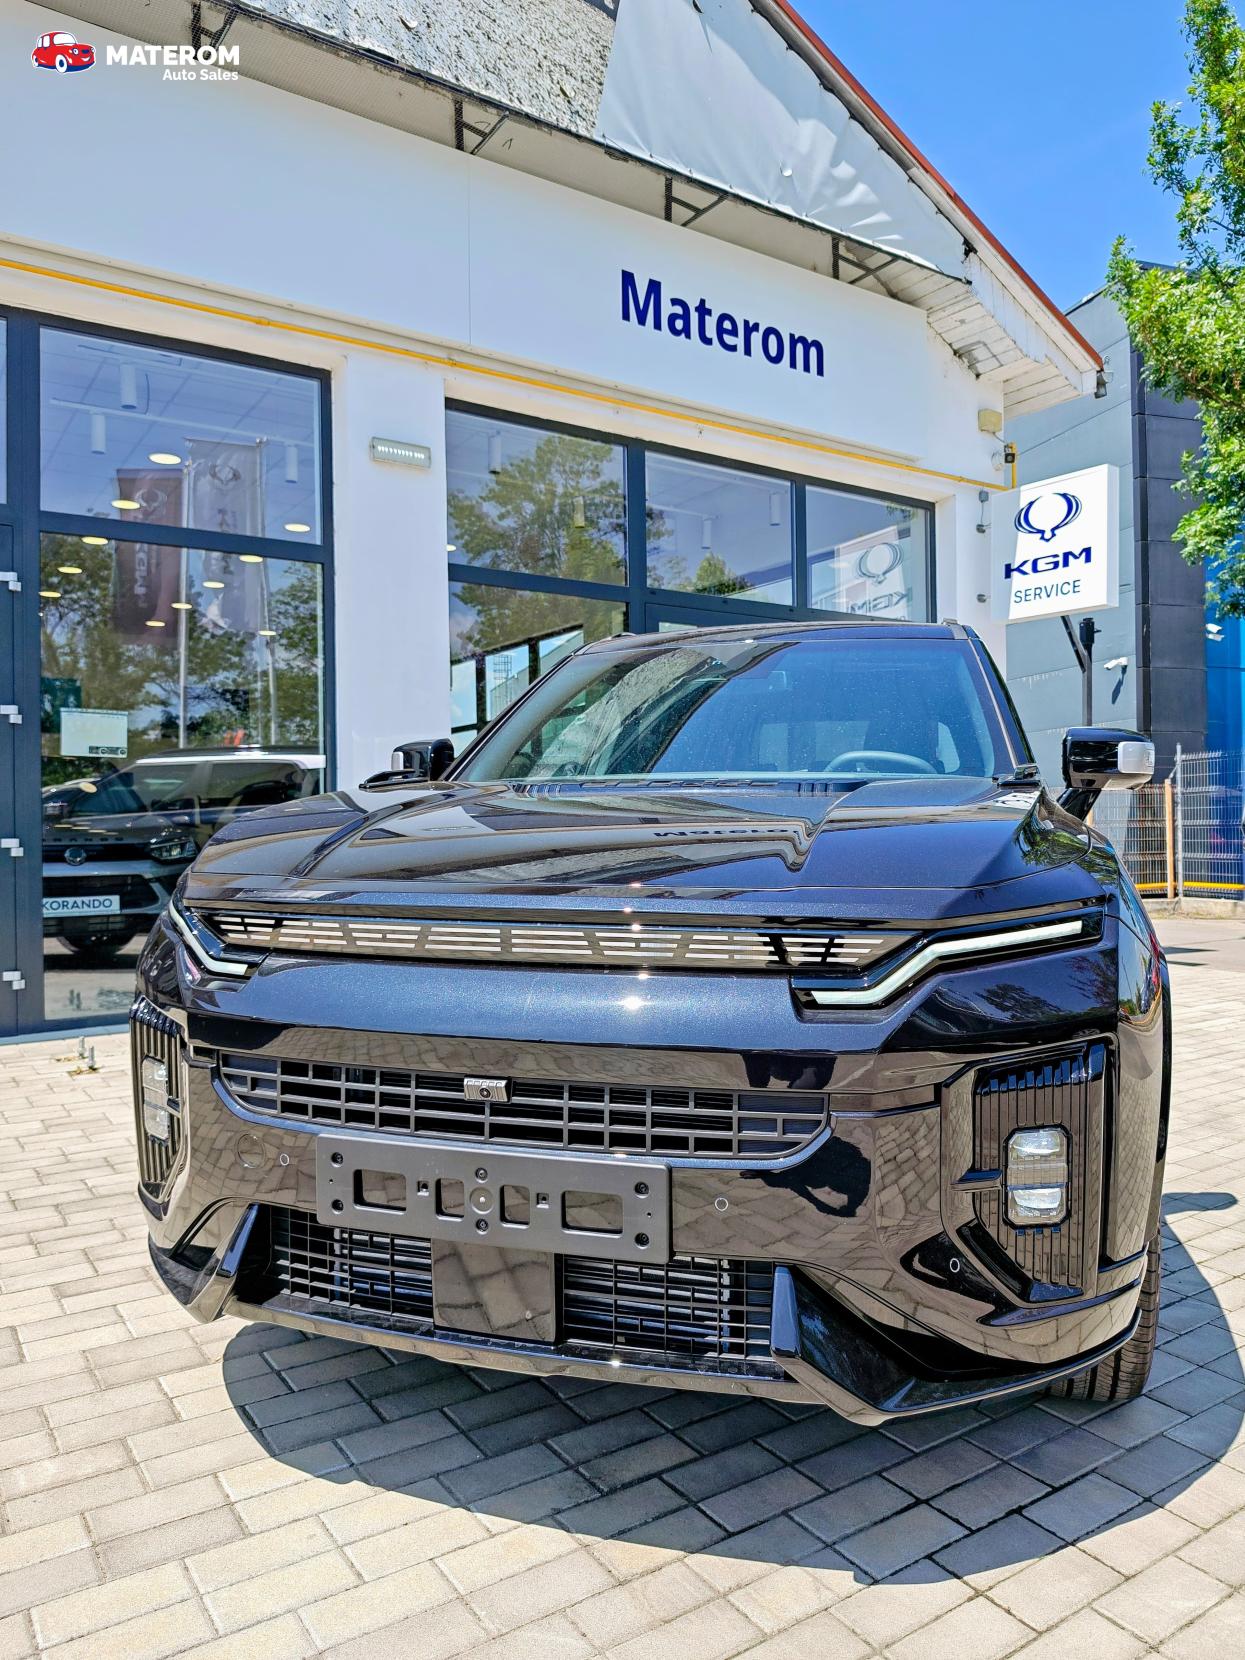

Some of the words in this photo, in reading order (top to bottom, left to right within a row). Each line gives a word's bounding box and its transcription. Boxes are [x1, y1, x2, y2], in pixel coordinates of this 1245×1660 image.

[621, 268, 825, 378] Materom
[1004, 546, 1092, 580] KGM
[1013, 579, 1082, 604] SERVICE
